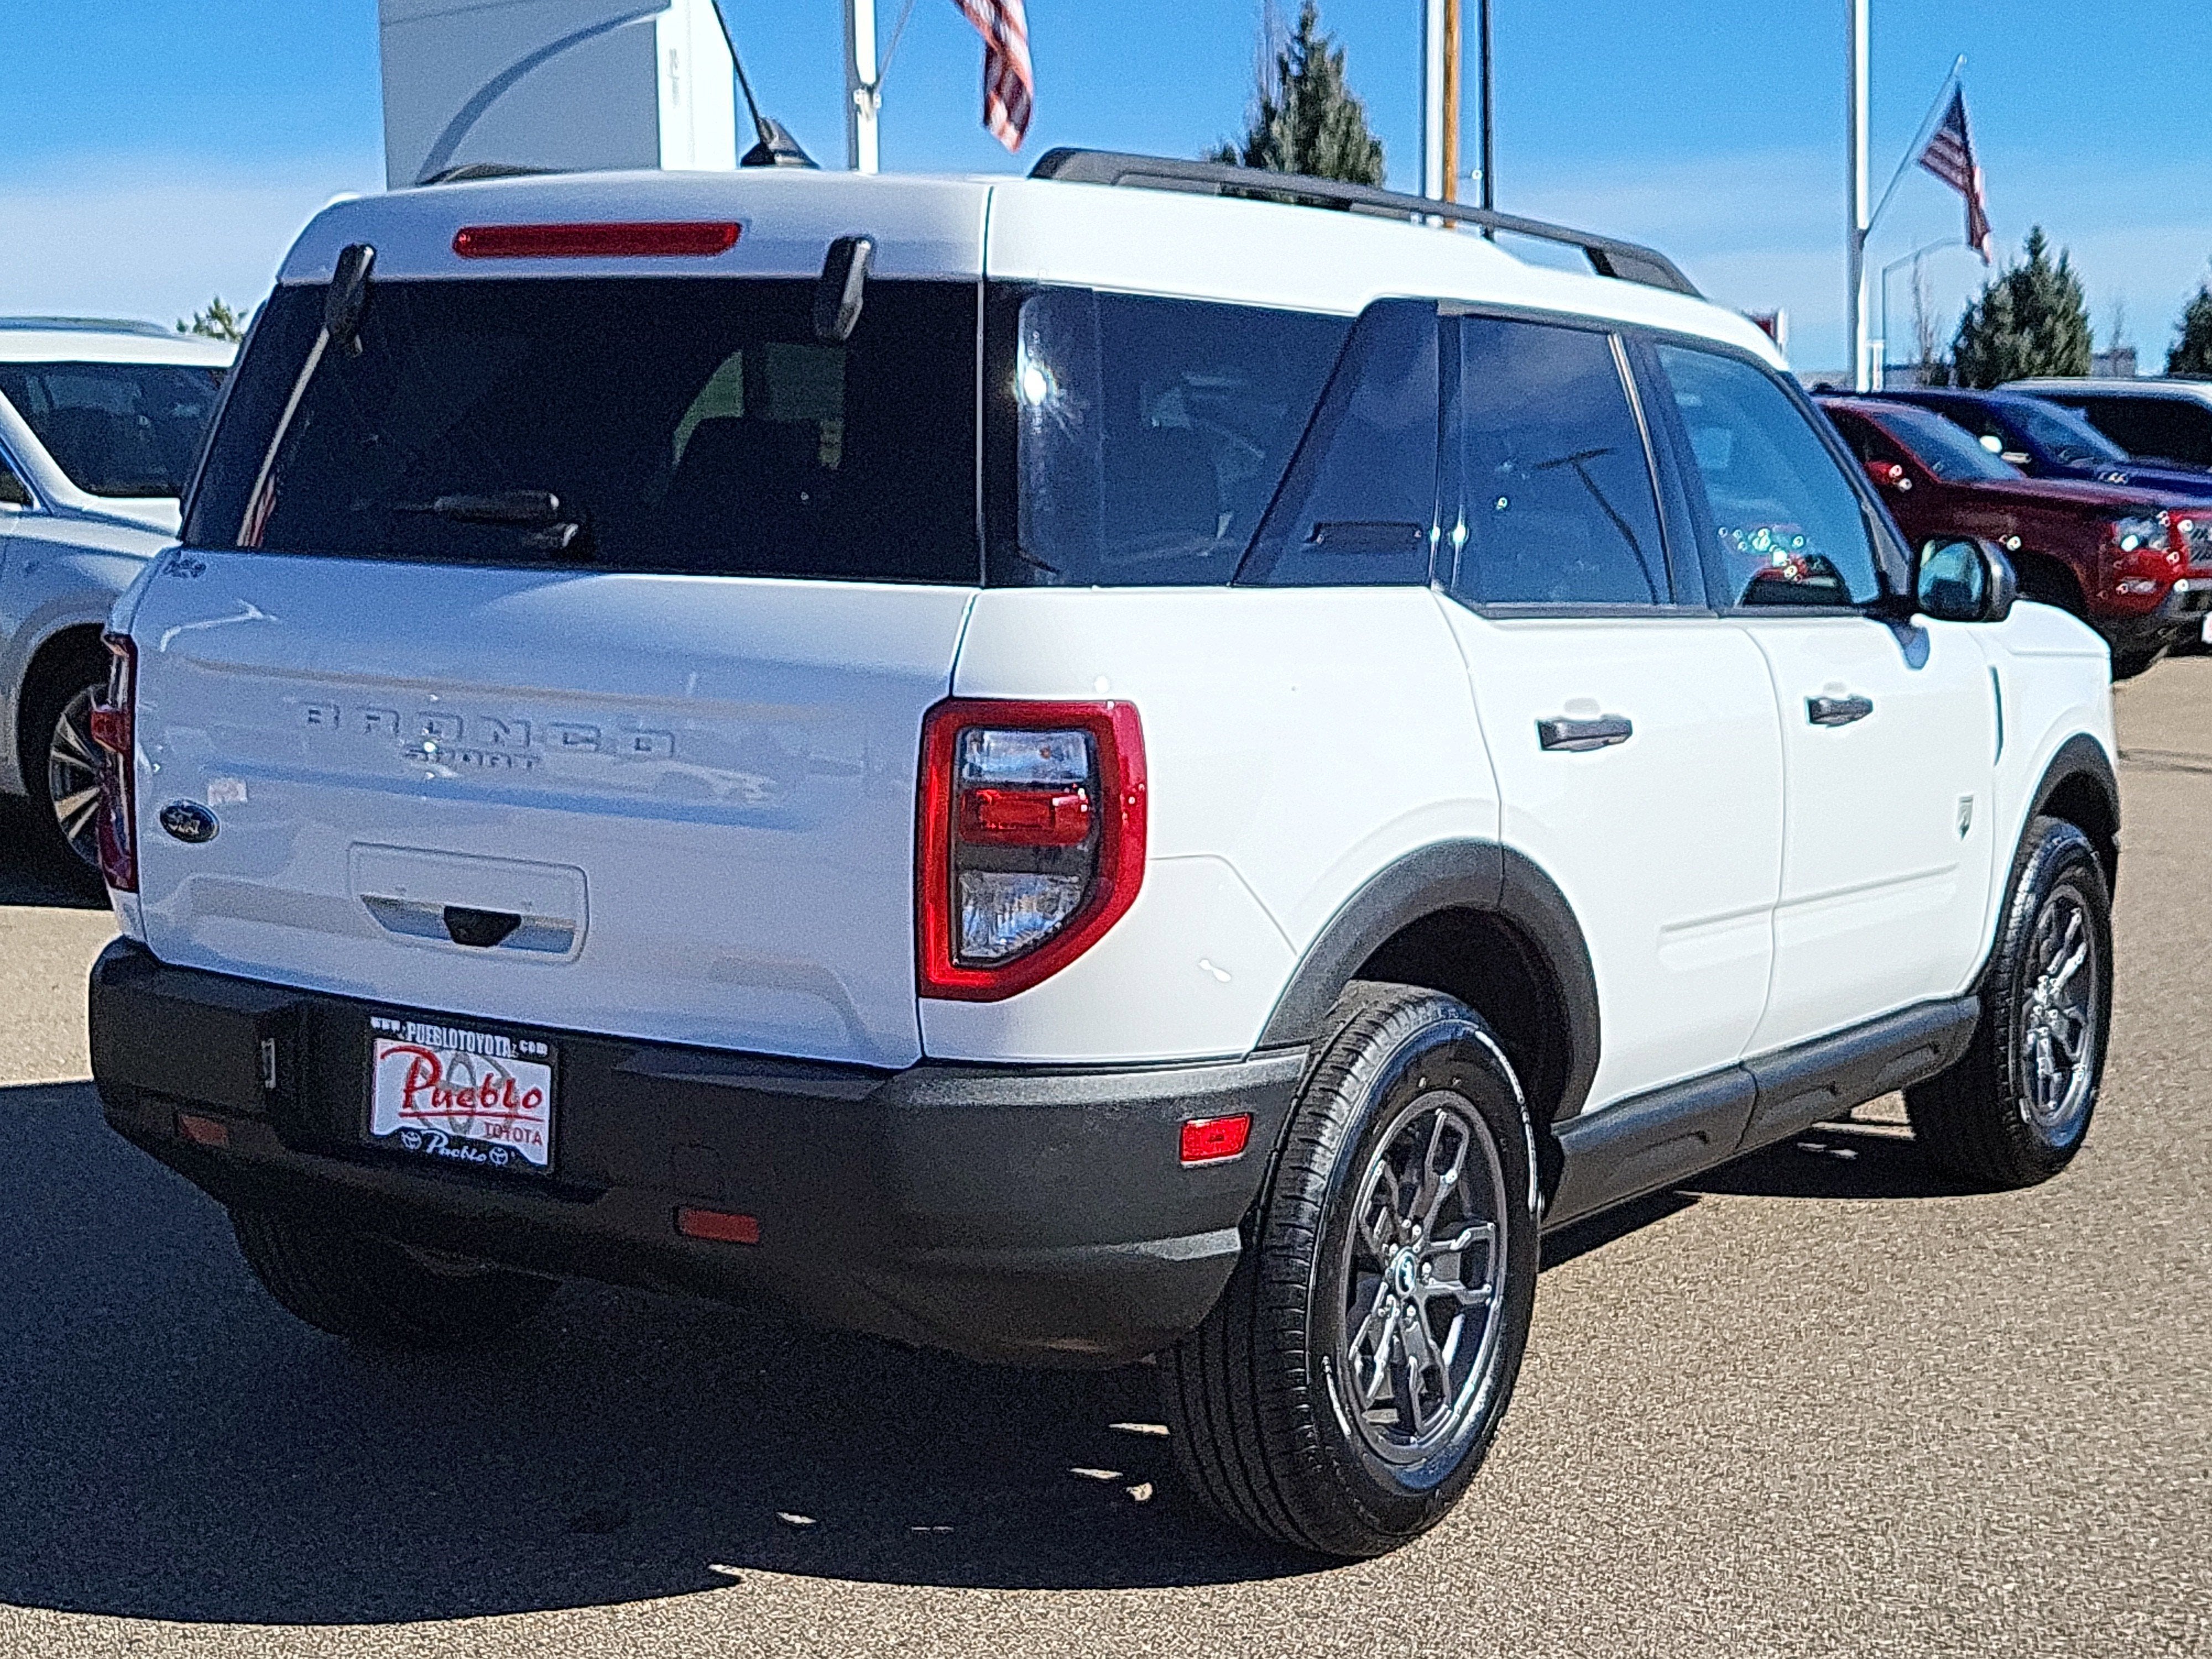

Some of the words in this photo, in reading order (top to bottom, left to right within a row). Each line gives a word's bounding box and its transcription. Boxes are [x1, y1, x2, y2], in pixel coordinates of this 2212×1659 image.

[300, 700, 676, 758] BRONCO
[380, 1045, 543, 1109] Pueblo
[420, 1130, 488, 1165] Pueblo
[483, 1121, 543, 1146] TOYOTA
